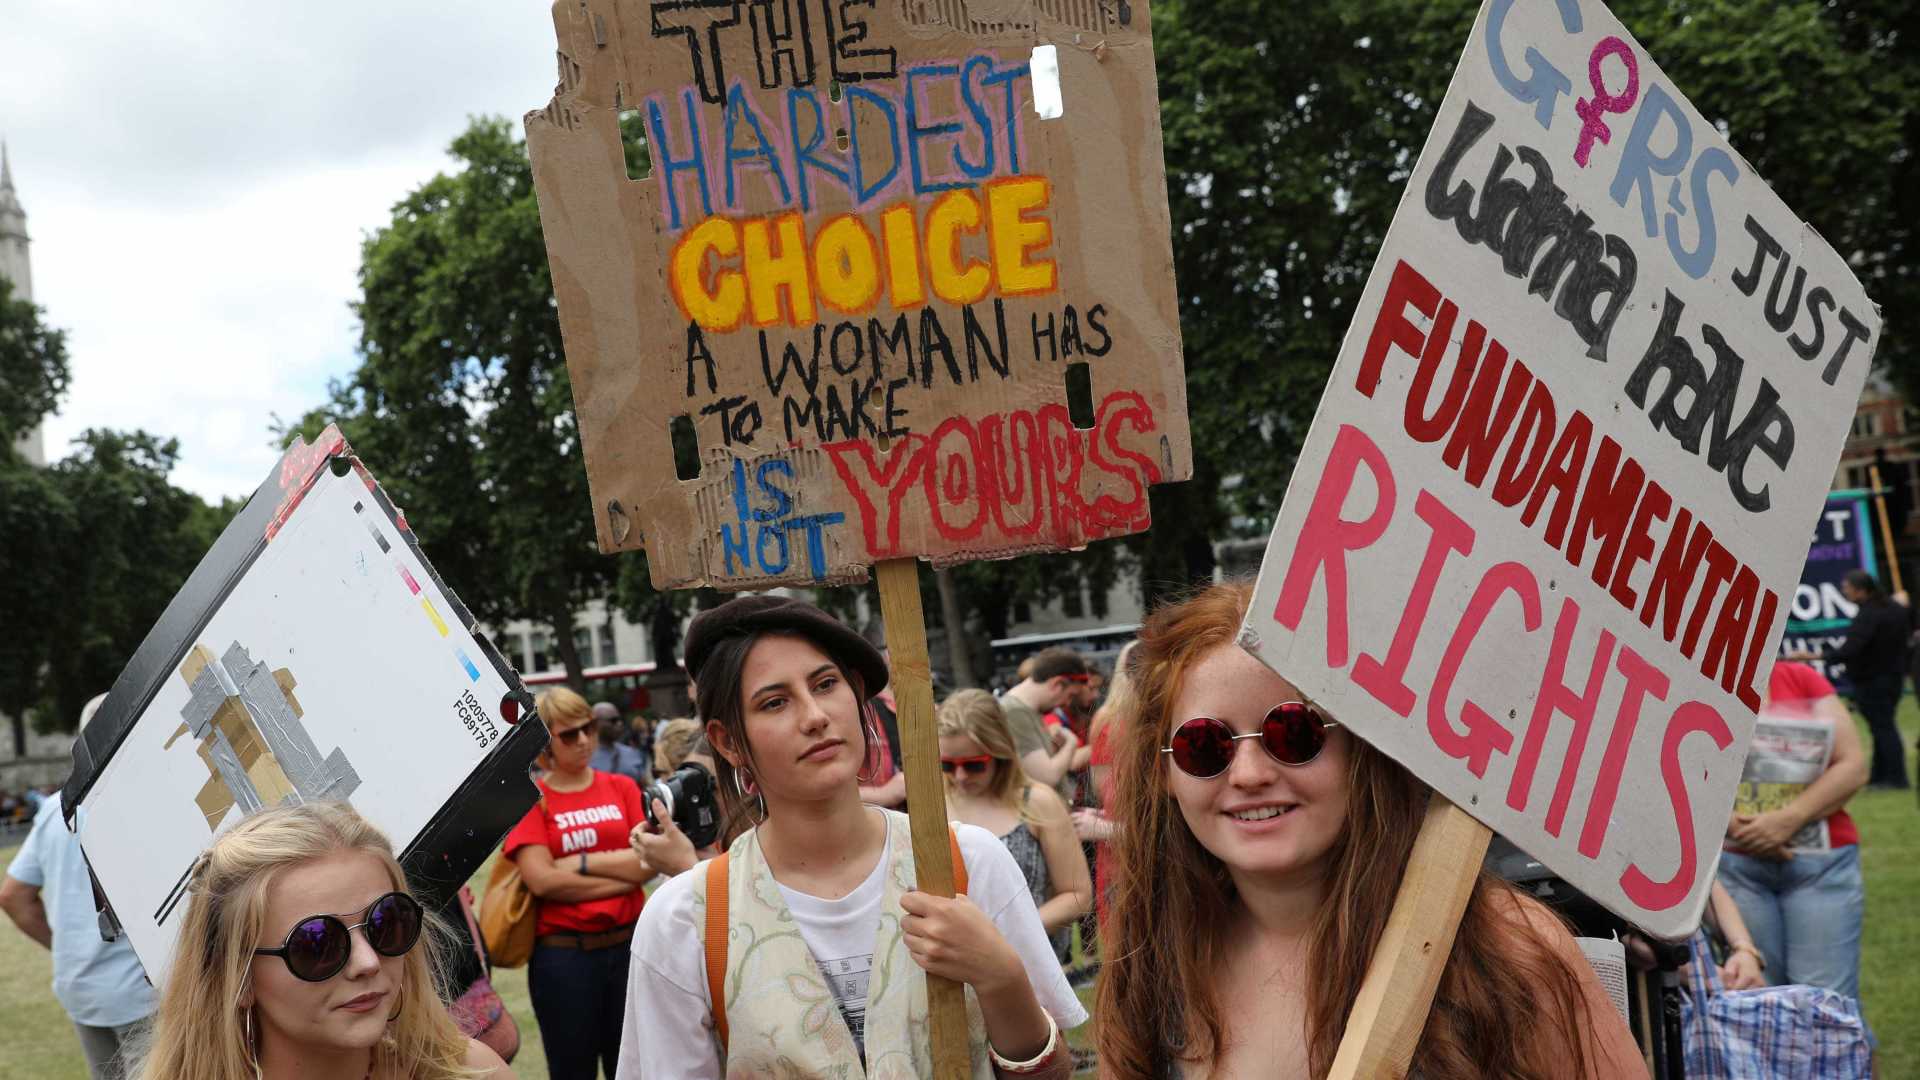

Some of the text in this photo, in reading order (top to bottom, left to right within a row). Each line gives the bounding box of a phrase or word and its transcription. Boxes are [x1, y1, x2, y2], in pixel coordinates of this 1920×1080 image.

[651, 0, 897, 107] THE
[643, 52, 1032, 231] HARDEST
[668, 174, 1057, 334] CHOICE
[1425, 99, 1796, 513] wanna have
[1731, 214, 1871, 386] JUST
[686, 298, 1112, 397] A WOMAN HAS
[700, 376, 911, 446] TO MAKE
[732, 390, 1162, 558] IS YOURS
[1355, 258, 1779, 716] FUNDAMENTAL
[720, 511, 845, 581] NOT
[461, 688, 499, 741] 10205778
[1273, 424, 1734, 912] RIGHTS
[453, 699, 489, 749] FC89179
[554, 804, 623, 829] STRONG
[562, 828, 598, 852] AND
